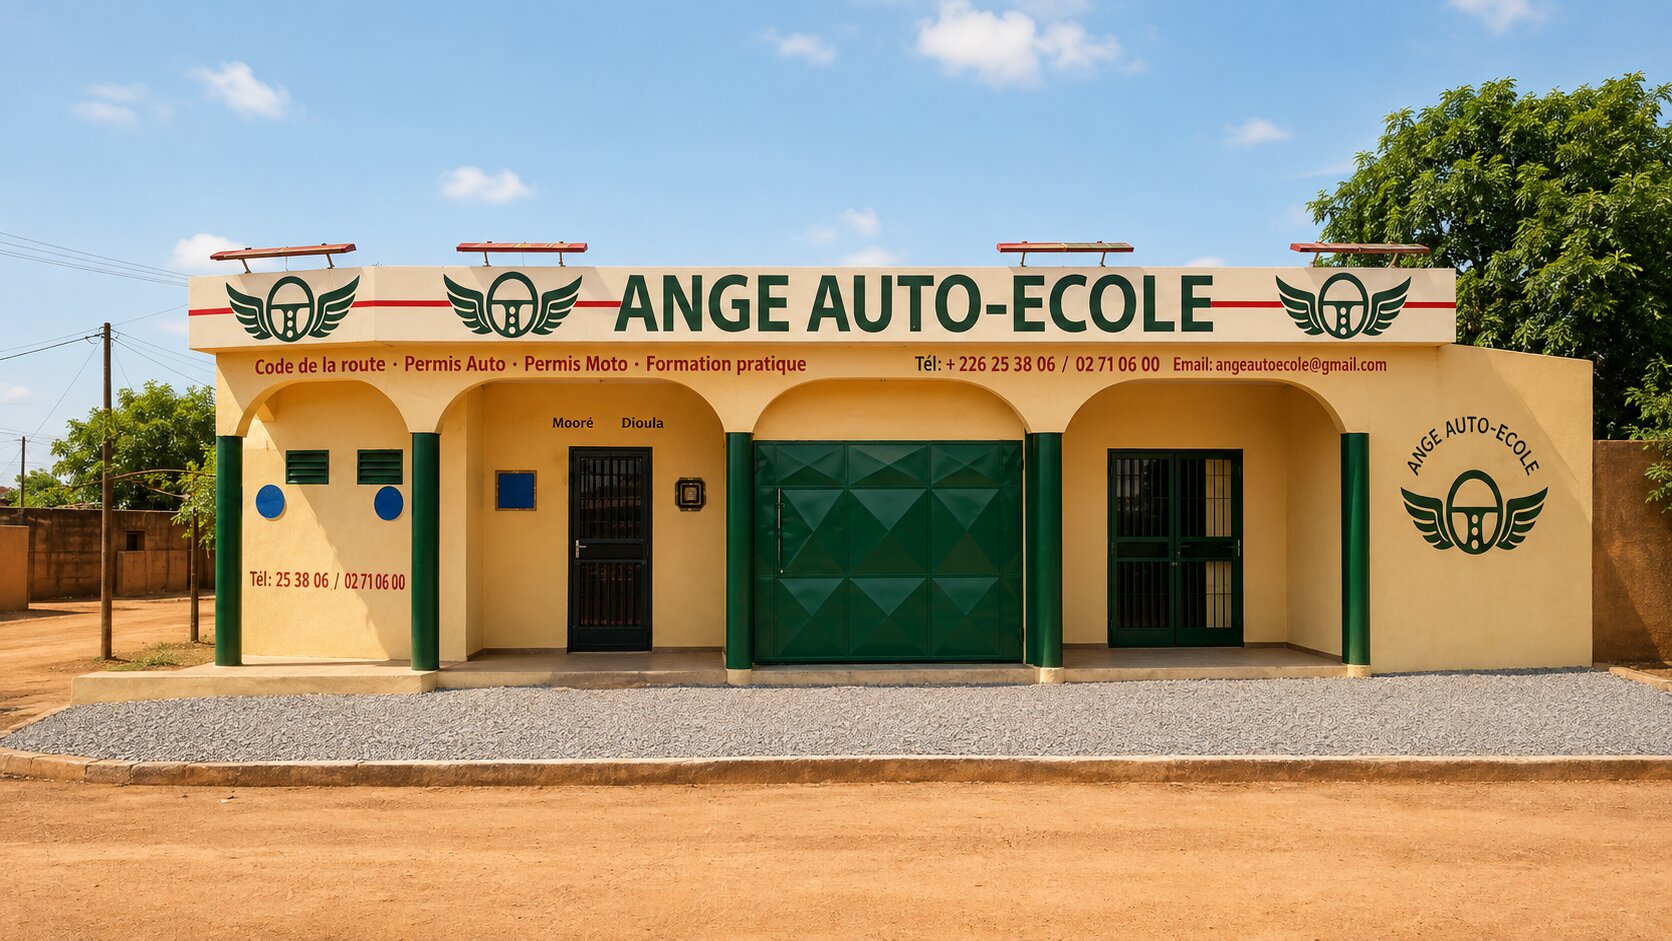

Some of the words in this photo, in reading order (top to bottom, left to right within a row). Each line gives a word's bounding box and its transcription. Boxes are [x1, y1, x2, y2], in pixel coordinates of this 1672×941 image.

[615, 274, 790, 333] ANGE
[807, 274, 1214, 333] AUTO-ECOLE
[255, 358, 294, 375] Code
[298, 358, 318, 374] de
[322, 356, 336, 373] la
[341, 357, 386, 372] route
[404, 355, 462, 372] Permis
[466, 356, 506, 372] Auto
[524, 355, 581, 372] Permis
[586, 355, 628, 372] Moto
[646, 355, 732, 372] Formation
[736, 355, 807, 375] pratique
[915, 355, 942, 372] Tél:
[959, 356, 987, 372] 226
[991, 356, 1009, 372] 25
[1013, 356, 1032, 372] 38
[1037, 356, 1056, 372] 06
[1075, 356, 1094, 372] 02
[1098, 356, 1113, 372] 71
[1118, 356, 1136, 372] 06
[1141, 356, 1160, 372] 00
[1173, 356, 1213, 372] Email:
[1216, 356, 1388, 376] angeautoecole@gmail.com
[552, 415, 594, 429] Mooré
[621, 416, 665, 429] Dioula
[1407, 428, 1442, 476] ANGE
[1445, 416, 1540, 476] AUTO-ECOLE
[276, 571, 291, 588] 25
[294, 572, 310, 588] 38
[313, 572, 329, 589] 06
